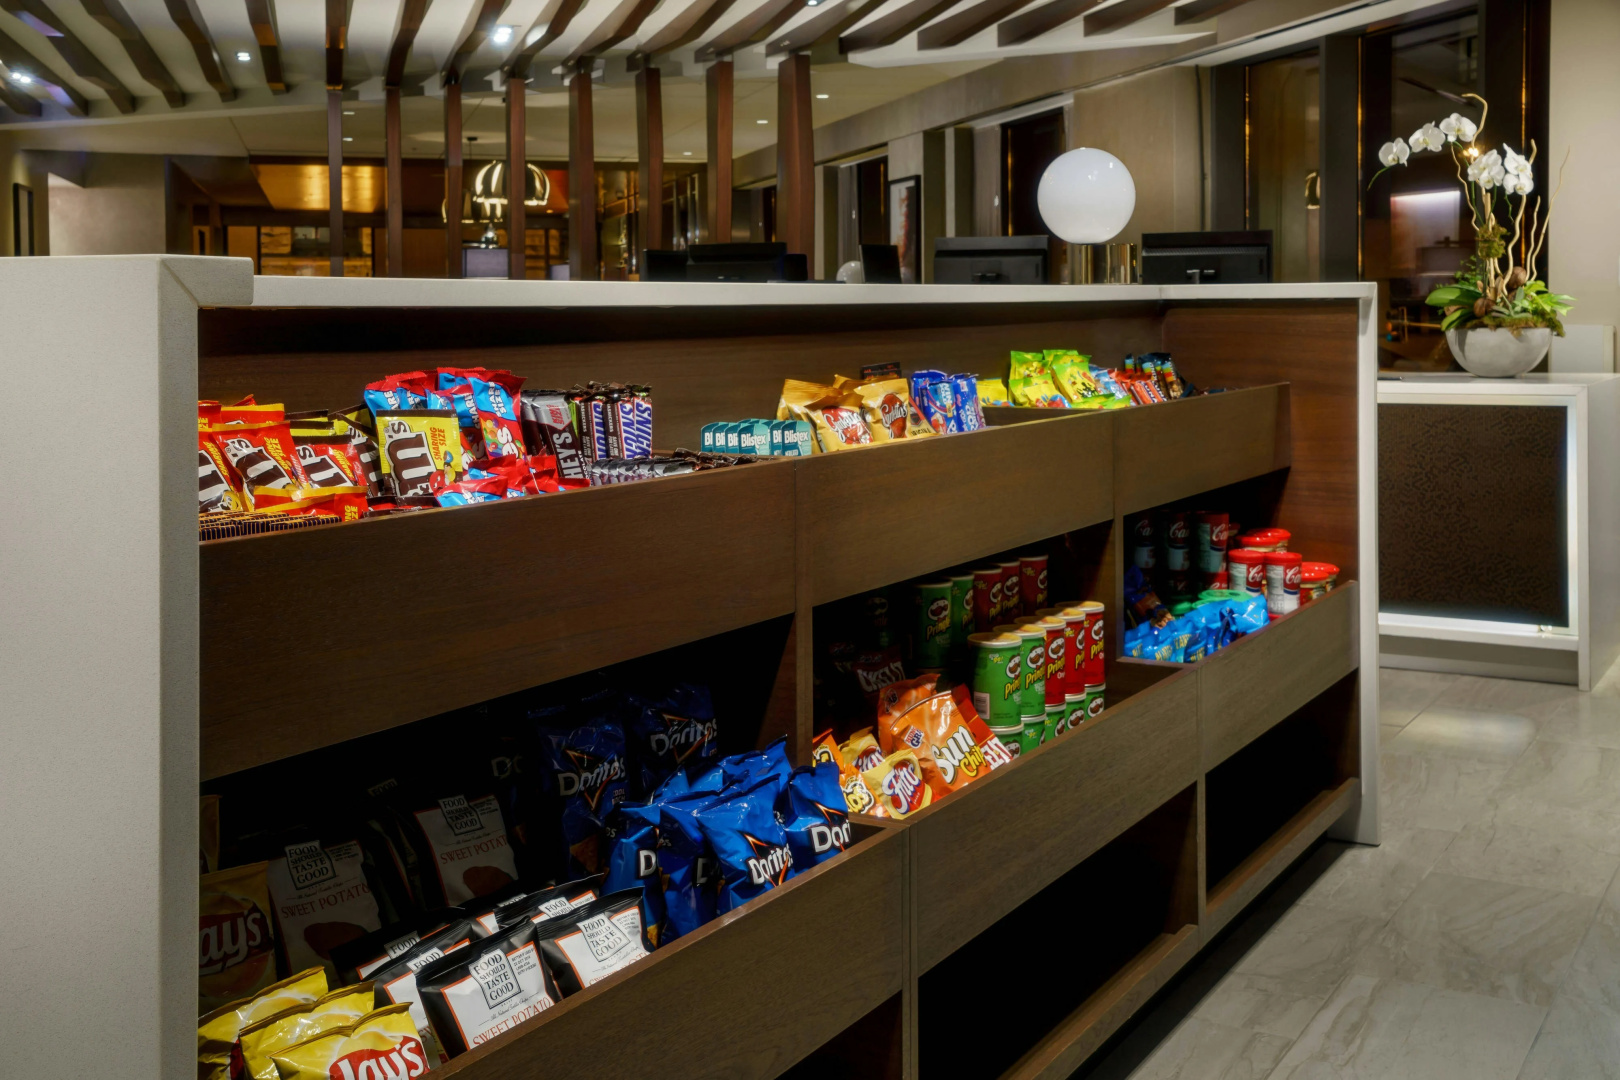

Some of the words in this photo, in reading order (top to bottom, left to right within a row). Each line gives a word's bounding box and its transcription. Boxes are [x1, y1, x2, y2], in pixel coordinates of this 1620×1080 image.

[488, 381, 502, 417] SHARE
[495, 389, 507, 414] SIZE
[438, 428, 446, 447] SIZE
[620, 403, 637, 459] SNICK
[635, 402, 652, 457] SNICK
[784, 430, 809, 445] Blistex
[270, 438, 286, 457] SIZE
[430, 426, 443, 461] SHARING
[741, 434, 767, 449] Blistex
[264, 437, 291, 471] SHARING
[553, 432, 584, 479] HEY'S
[932, 726, 974, 784] Sun
[557, 757, 626, 797] Doritos
[442, 799, 466, 809] FOOD
[449, 812, 475, 822] TASTE
[454, 819, 478, 831] GOOD
[811, 822, 850, 854] Dori
[288, 844, 318, 858] FOOD
[290, 852, 321, 865] SHOULD
[440, 845, 472, 865] SWEET
[294, 857, 327, 874] TASTE
[747, 842, 793, 886] Doritos
[296, 866, 329, 884] GOOD
[281, 901, 317, 919] SWEET
[544, 899, 568, 913] FOOD
[582, 917, 606, 933] FOOD
[587, 926, 612, 939] SHOULD
[199, 911, 262, 970] ay's
[390, 936, 420, 955] FOOD
[590, 929, 617, 949] TASTE
[595, 937, 622, 957] GOOD
[473, 952, 503, 976] FOOD
[479, 963, 506, 981] SHOULD
[484, 971, 511, 990] TASTE
[489, 981, 515, 1001] GOOD
[511, 996, 552, 1026] POTATO
